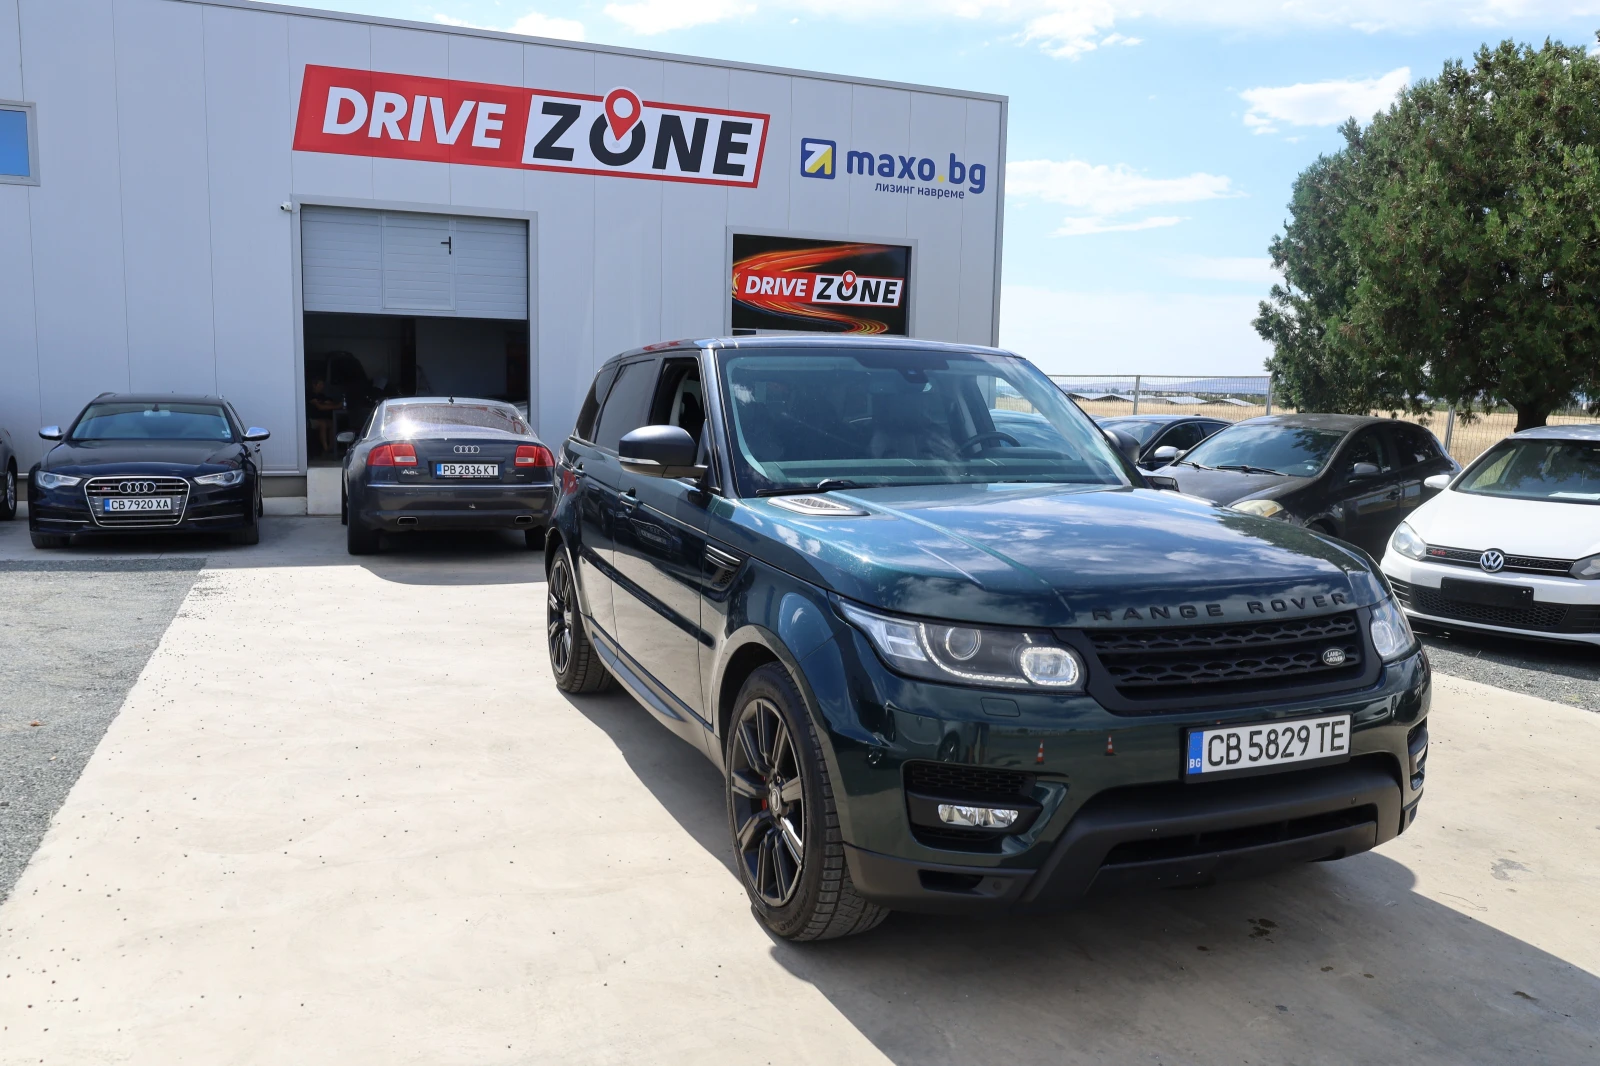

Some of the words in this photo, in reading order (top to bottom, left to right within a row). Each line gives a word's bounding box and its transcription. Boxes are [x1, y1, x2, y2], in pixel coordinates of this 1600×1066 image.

[322, 86, 507, 149] DRIVE
[533, 101, 753, 177] ZONE
[846, 150, 986, 194] maxo.bg
[875, 182, 915, 195] лизинг
[917, 186, 965, 200] навреме
[745, 275, 808, 297] DRIVE
[816, 277, 898, 304] ZONE
[443, 465, 456, 475] PB
[458, 465, 482, 475] 2836
[483, 465, 497, 475] KT
[111, 500, 126, 510] CB
[127, 499, 154, 510] 7920
[155, 499, 169, 509] XA
[1092, 603, 1224, 621] RANGE
[1246, 592, 1348, 614] ROVER
[1207, 732, 1243, 767] CB
[1248, 725, 1311, 762] 5829
[1315, 719, 1346, 754] TE
[1189, 758, 1202, 769] BG
